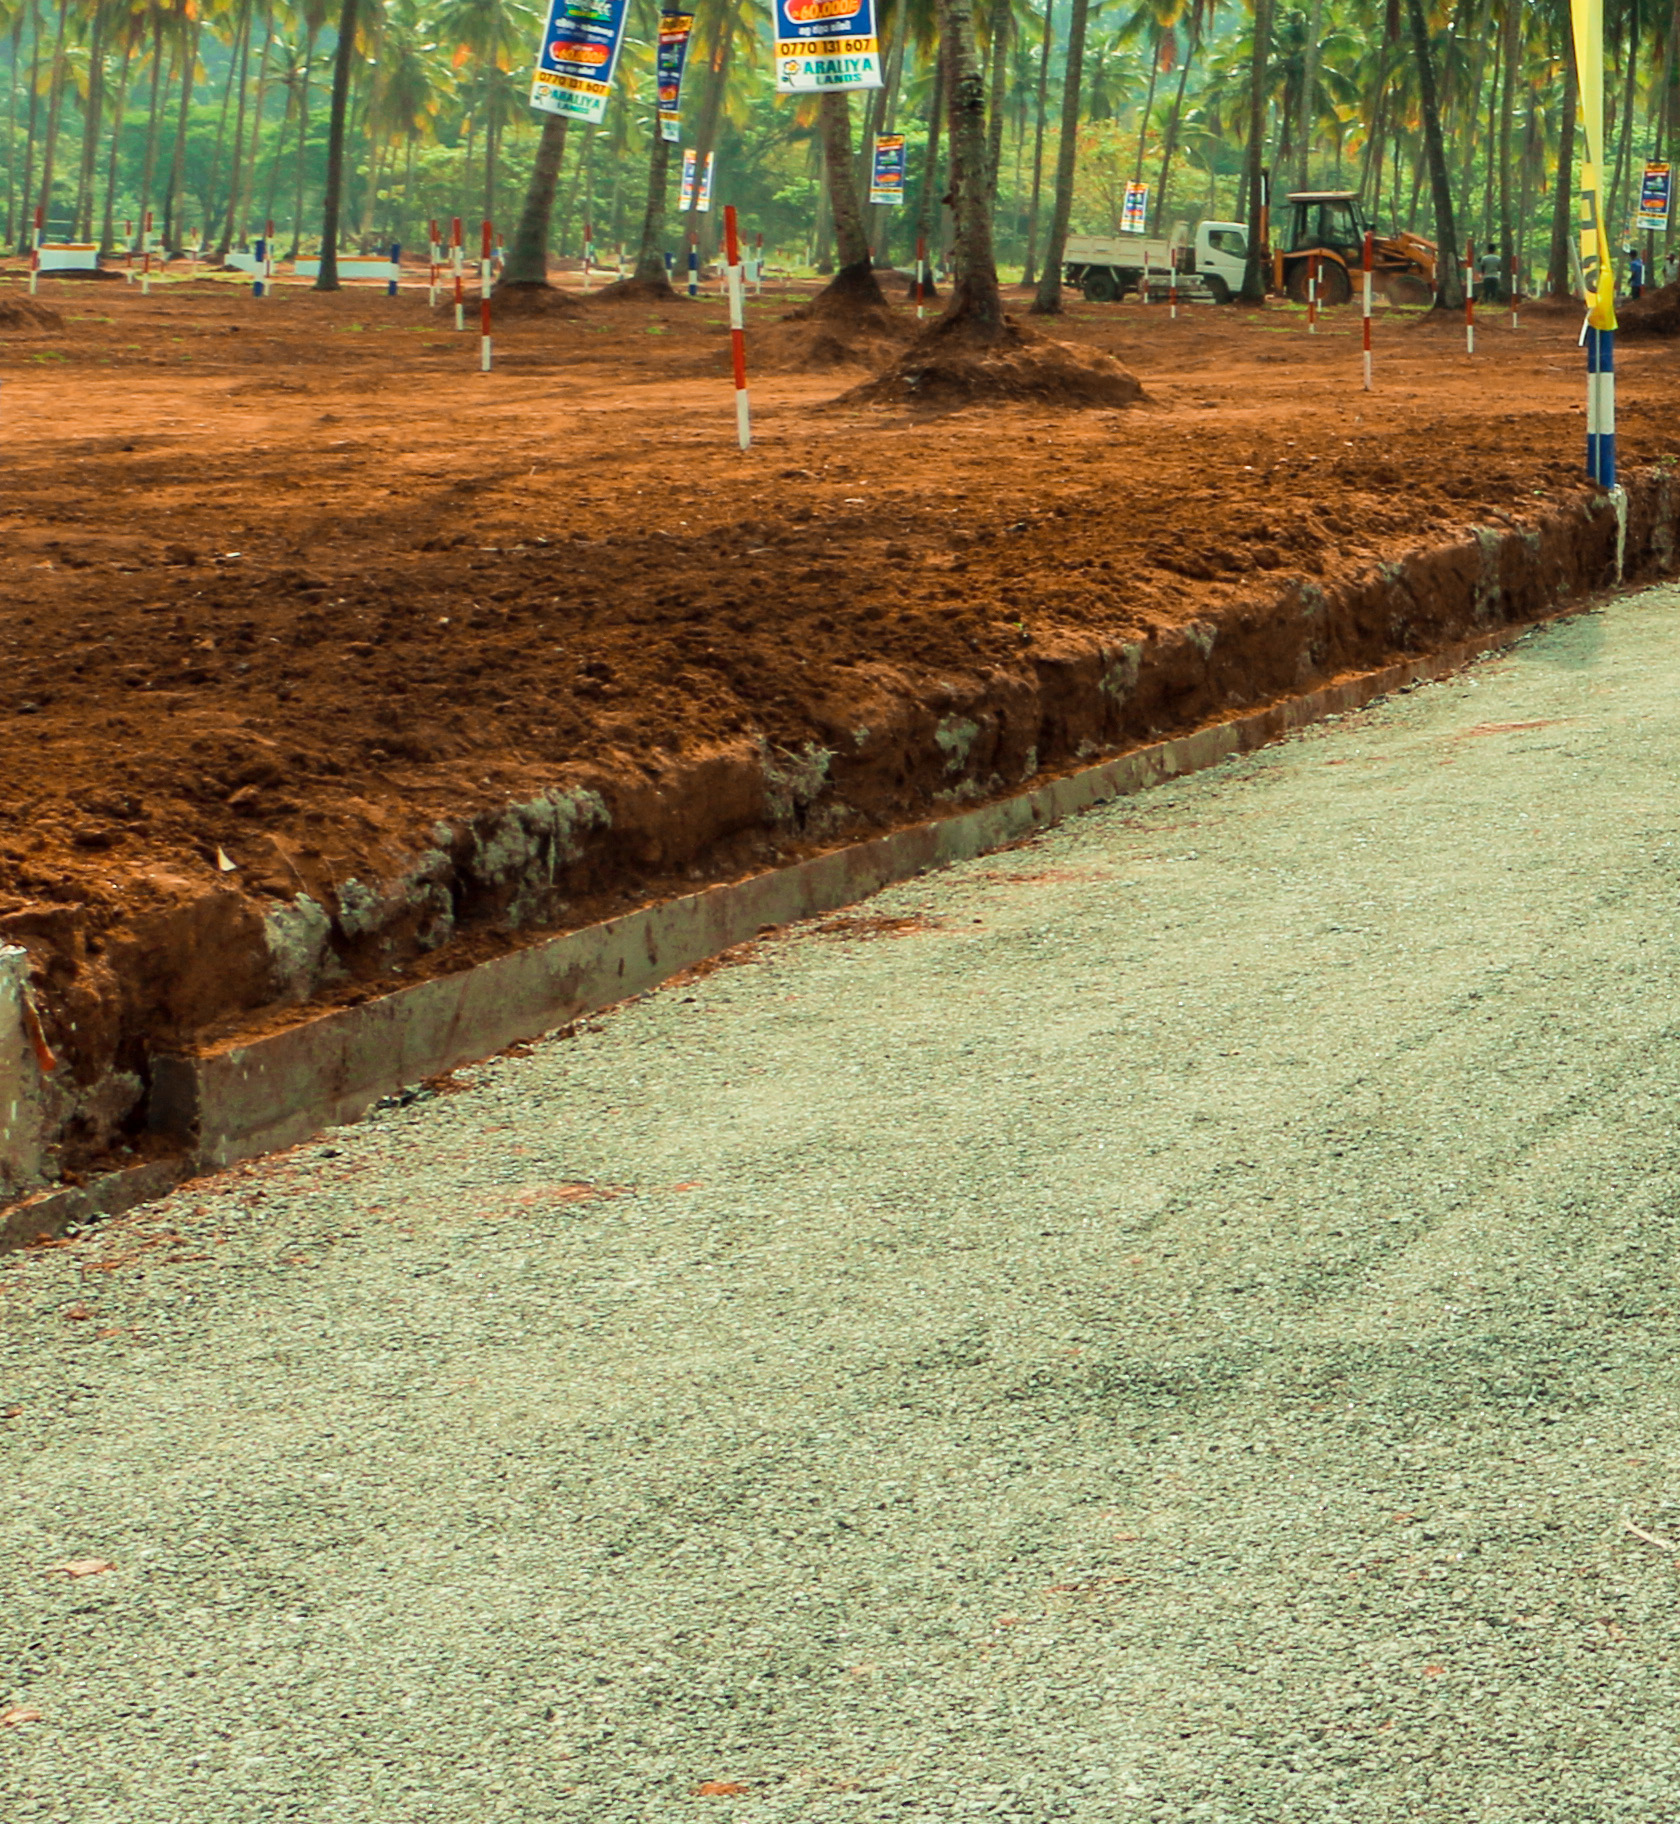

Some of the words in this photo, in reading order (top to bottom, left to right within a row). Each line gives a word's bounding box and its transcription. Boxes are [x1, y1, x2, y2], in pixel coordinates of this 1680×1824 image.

[781, 41, 817, 56] 0770
[823, 40, 841, 53] 131
[845, 38, 871, 52] 607
[804, 57, 873, 75] ARALIYA
[816, 73, 862, 86] LANDS
